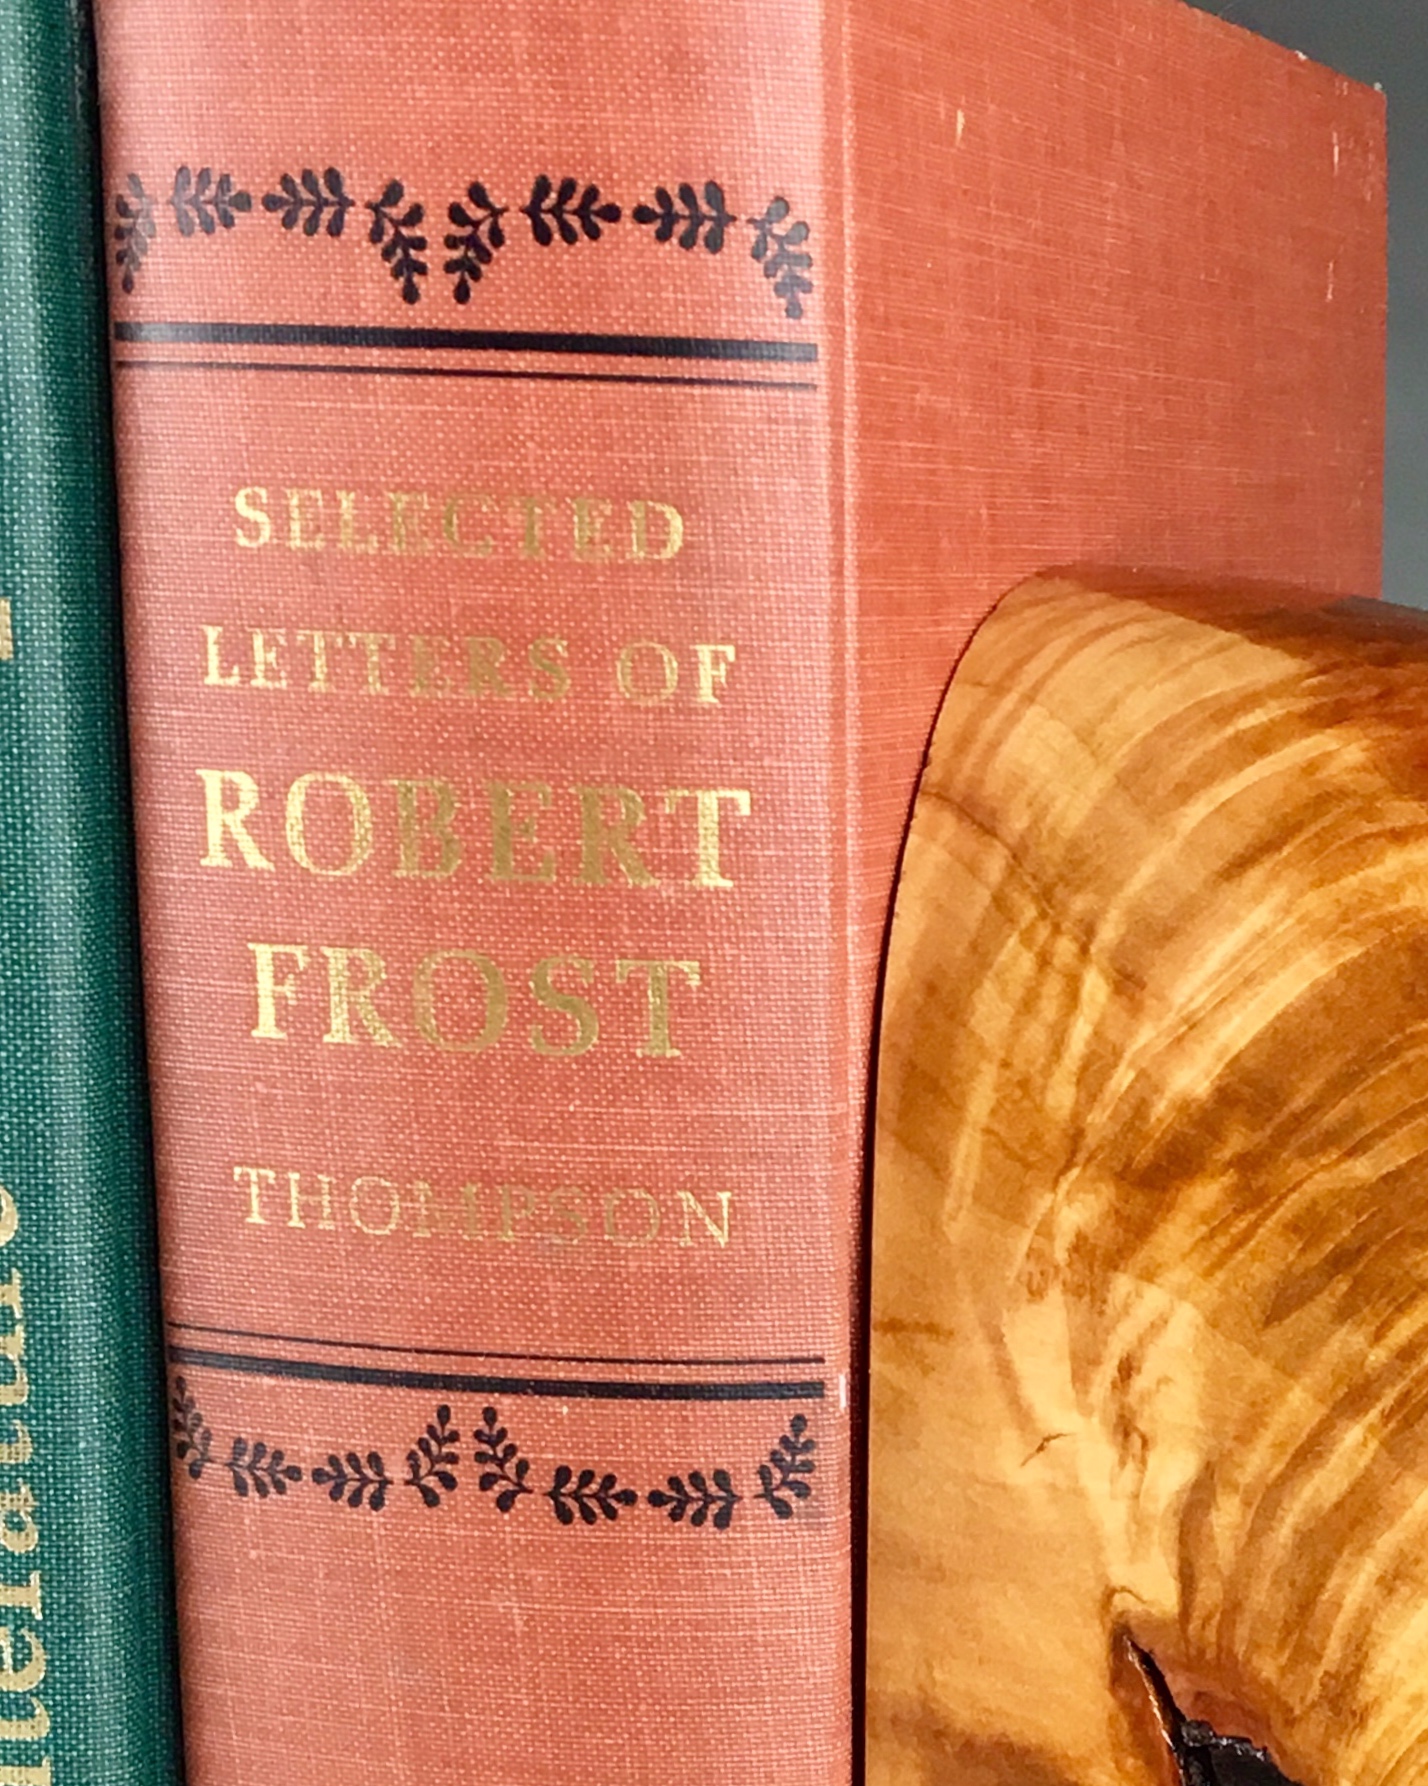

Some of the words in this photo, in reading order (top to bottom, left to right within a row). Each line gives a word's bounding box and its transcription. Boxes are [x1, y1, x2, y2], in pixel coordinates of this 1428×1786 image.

[233, 486, 685, 564] SELECTED
[201, 624, 572, 702] LETTERS
[614, 640, 737, 707] OF
[195, 767, 752, 890] ROBERT
[246, 942, 702, 1059] FROST
[232, 1166, 733, 1250] THOMPSON
